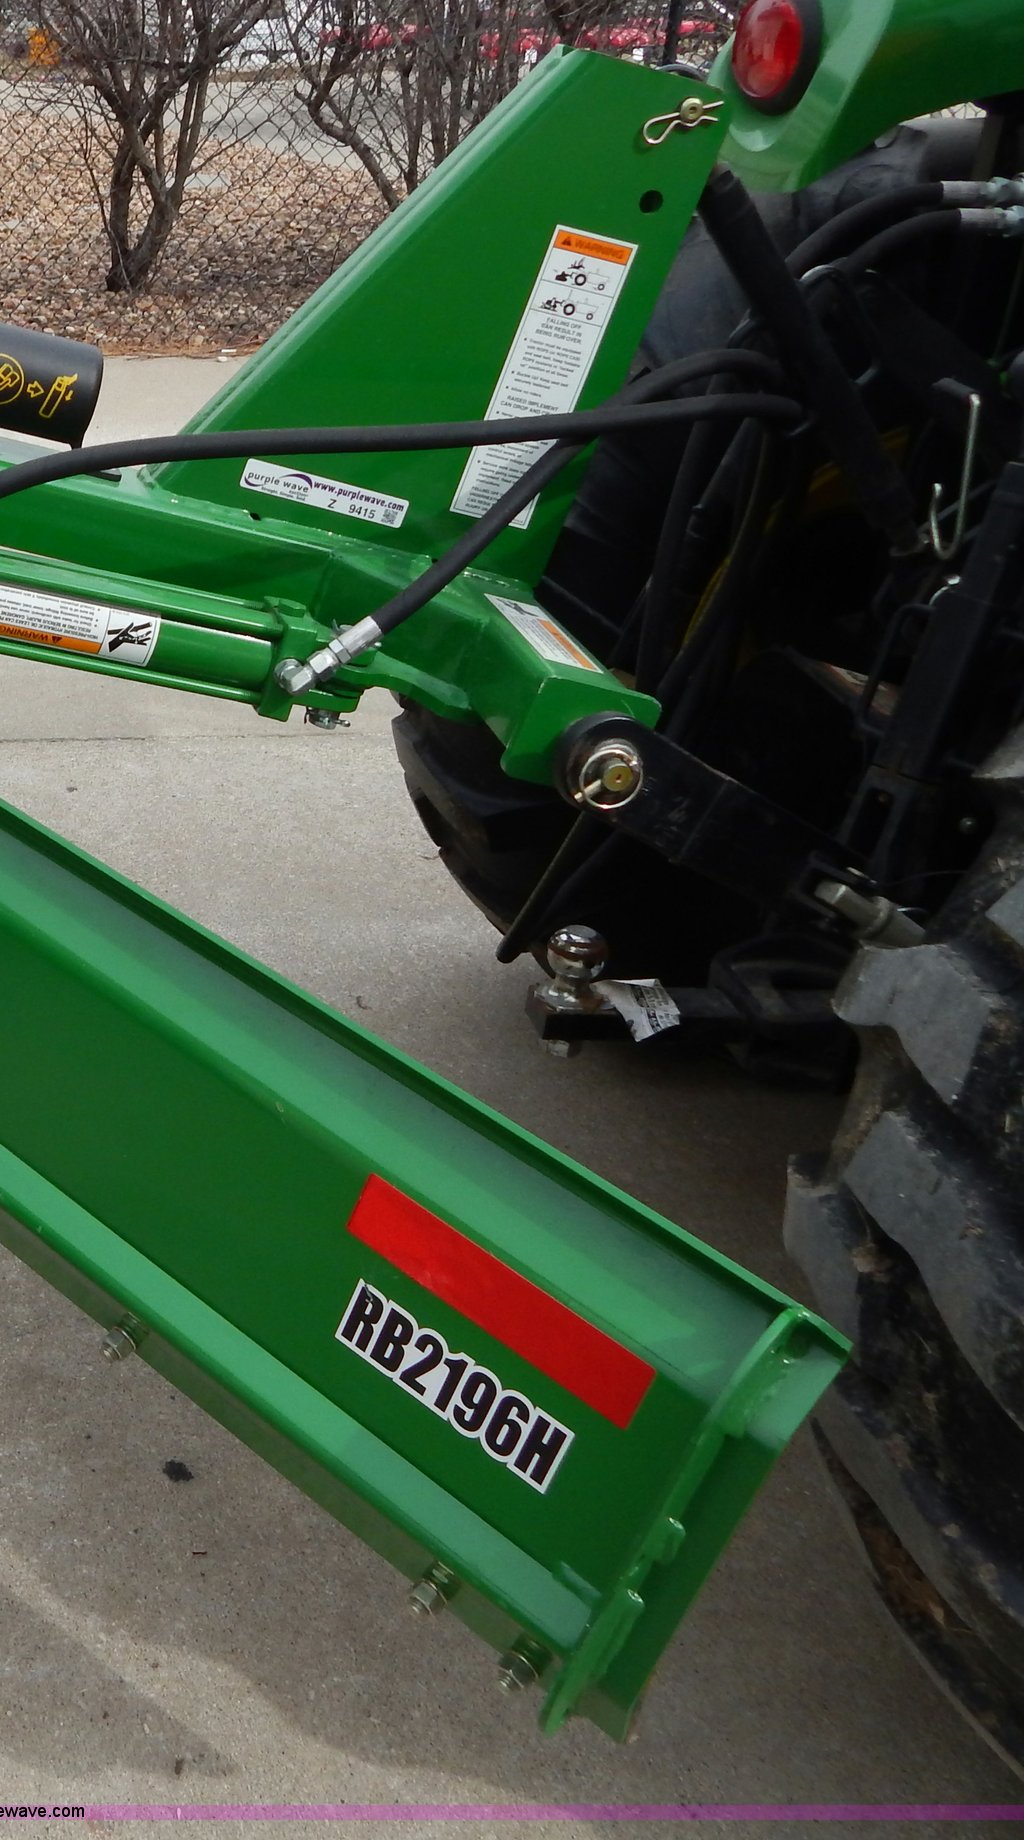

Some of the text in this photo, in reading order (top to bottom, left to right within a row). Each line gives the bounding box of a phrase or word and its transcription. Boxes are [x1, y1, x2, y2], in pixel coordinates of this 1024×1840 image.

[573, 238, 624, 259] WARNING
[527, 400, 558, 411] IMPLEMENT
[247, 471, 309, 493] purple wave
[313, 480, 405, 512] www.purplewave.com
[327, 498, 376, 519] Z 9415
[341, 1287, 567, 1486] RB2196H
